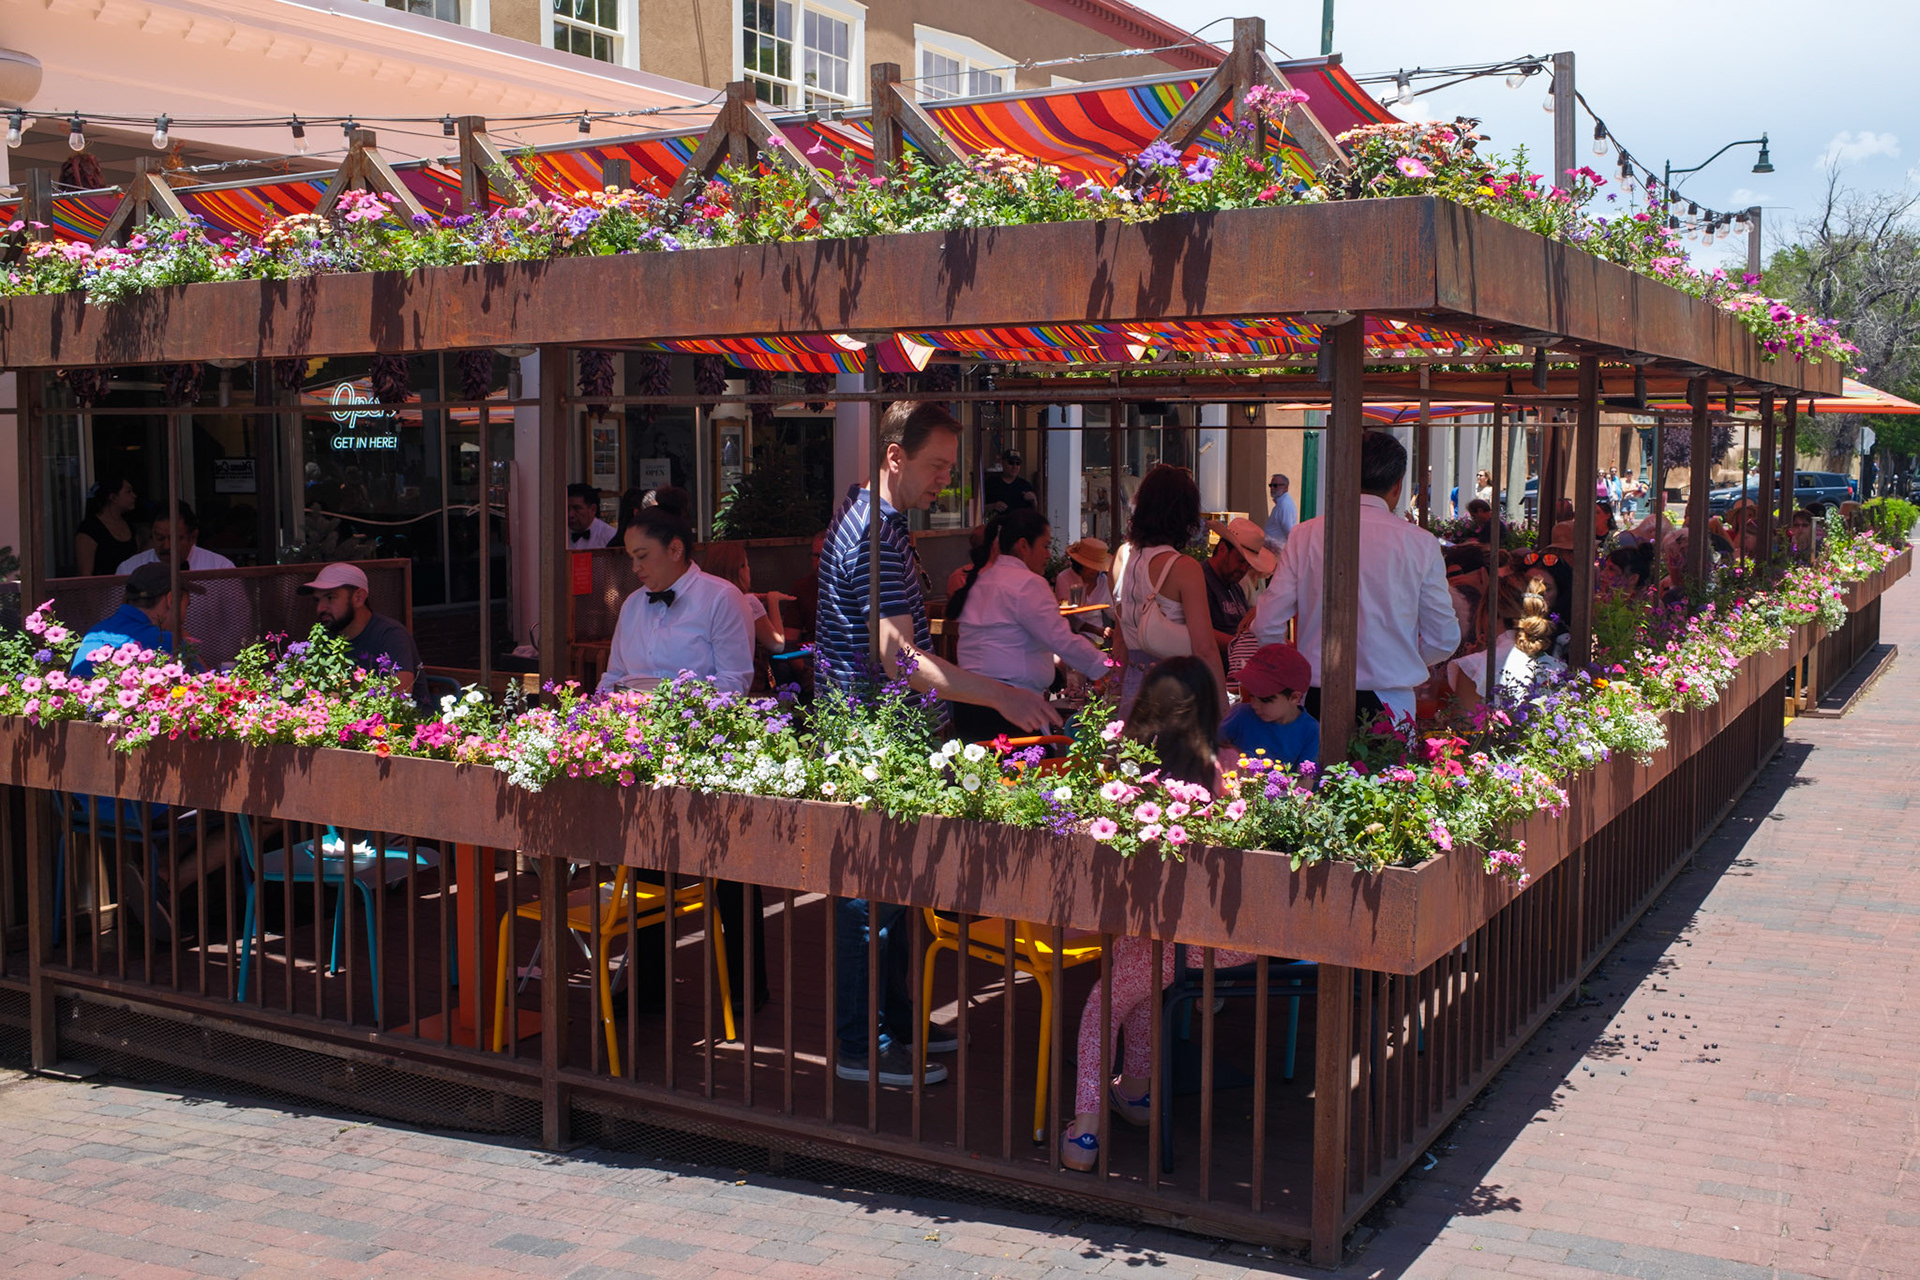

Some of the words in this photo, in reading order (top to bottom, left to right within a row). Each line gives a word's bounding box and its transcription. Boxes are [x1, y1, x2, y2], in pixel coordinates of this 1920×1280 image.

[333, 437, 355, 449] GET
[356, 437, 367, 449] IN
[369, 437, 398, 449] HERE!
